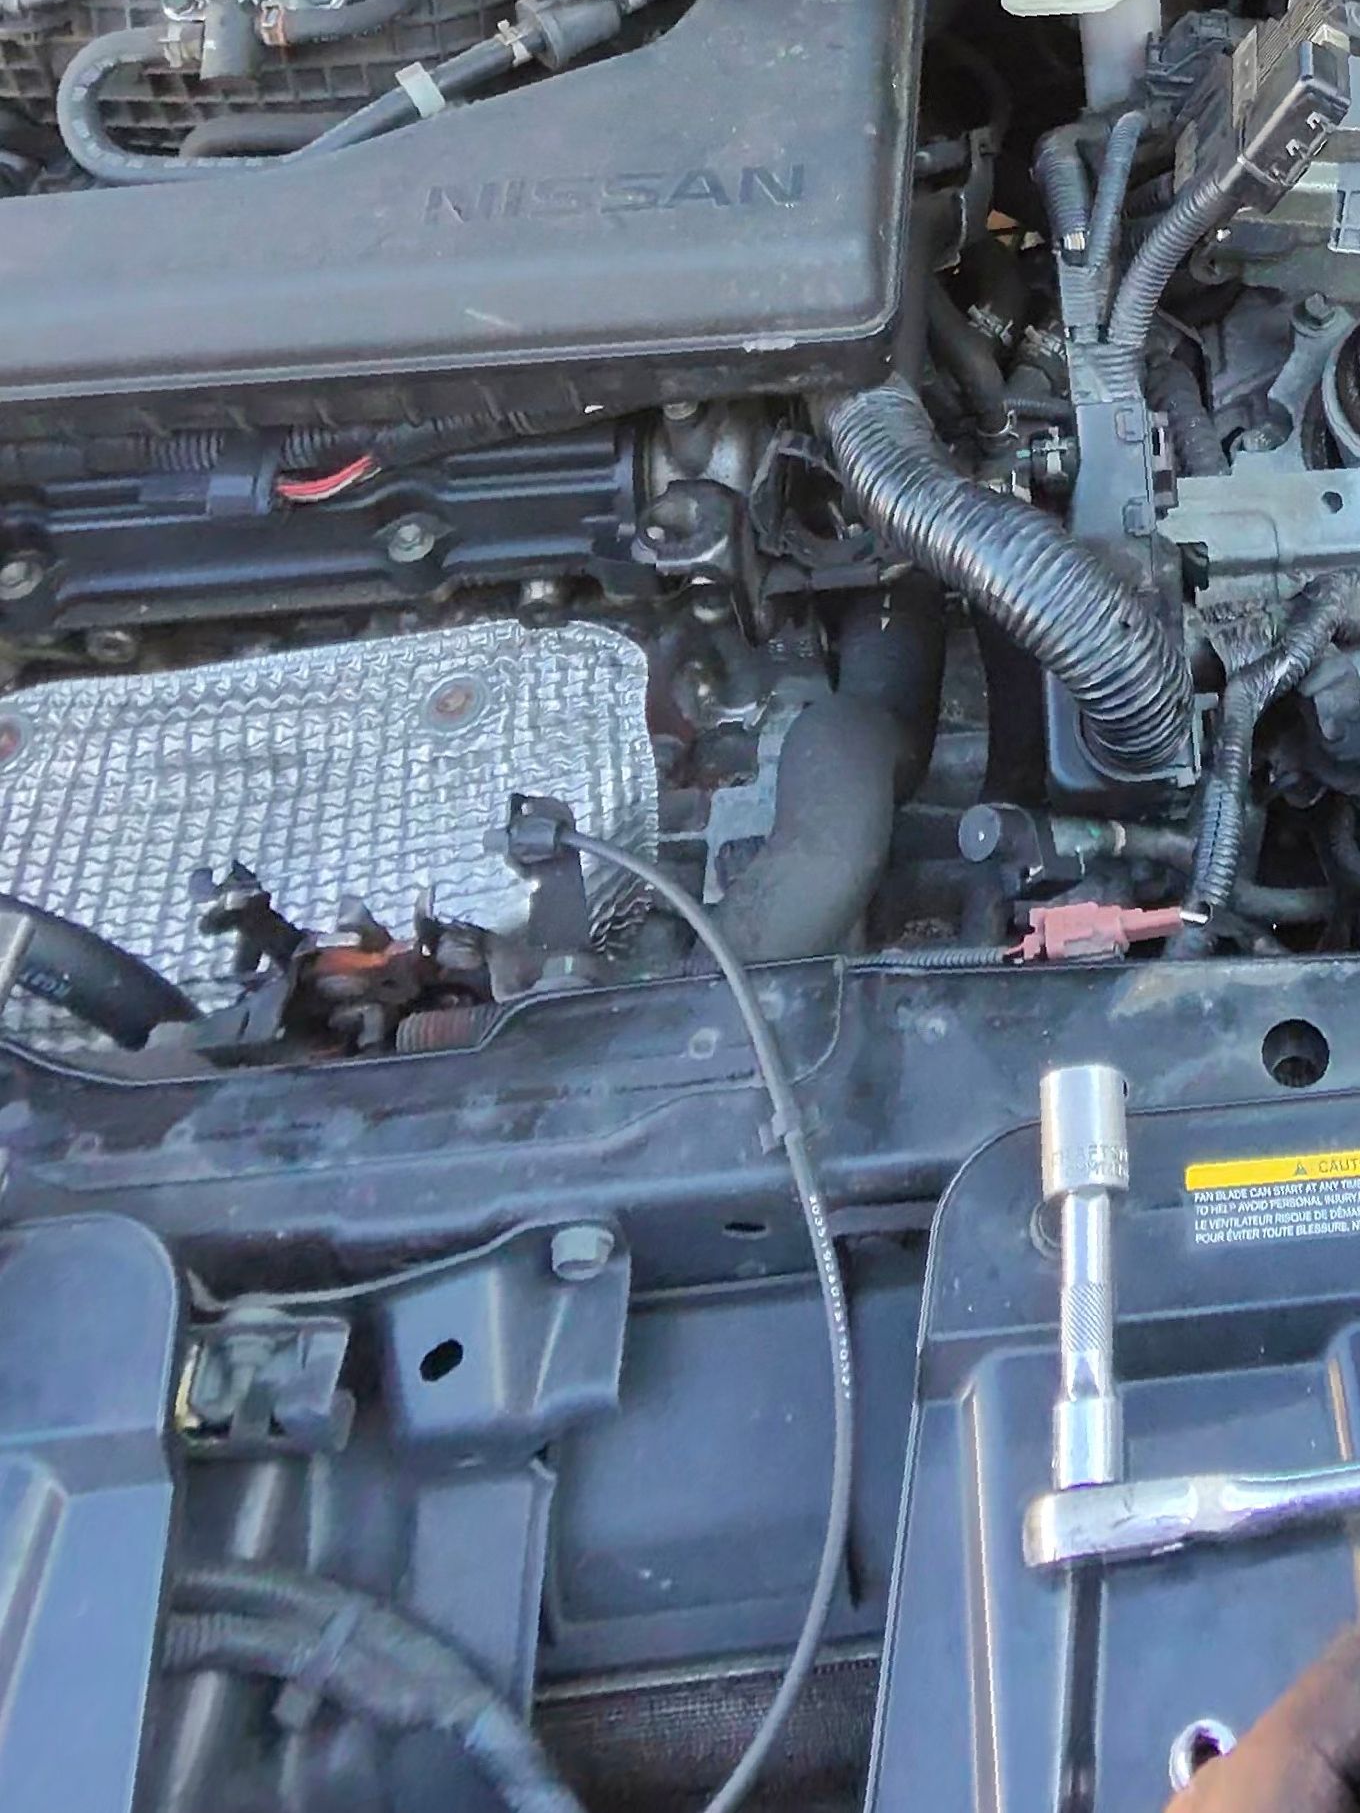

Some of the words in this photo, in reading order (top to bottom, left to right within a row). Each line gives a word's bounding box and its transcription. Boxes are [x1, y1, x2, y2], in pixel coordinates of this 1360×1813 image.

[422, 163, 804, 225] NISSAN
[1194, 1191, 1214, 1202] FAN
[1215, 1189, 1248, 1201] BLADE
[1249, 1186, 1271, 1198] CAN
[1273, 1182, 1303, 1196] START
[1305, 1182, 1317, 1194] AT
[1319, 1180, 1339, 1193] ANY
[1195, 1204, 1208, 1216] TO
[1210, 1202, 1236, 1214] HELP
[1238, 1199, 1268, 1213] AVOID
[1269, 1195, 1323, 1209] PERSONAL
[1195, 1219, 1207, 1230] LE
[1209, 1213, 1273, 1230] VENTILATEUR
[1274, 1211, 1312, 1224] RISQUE
[1314, 1209, 1328, 1220] DE
[1195, 1231, 1224, 1244] POUR
[1226, 1227, 1260, 1242] ÉVITER
[1261, 1225, 1294, 1238] TOUTE
